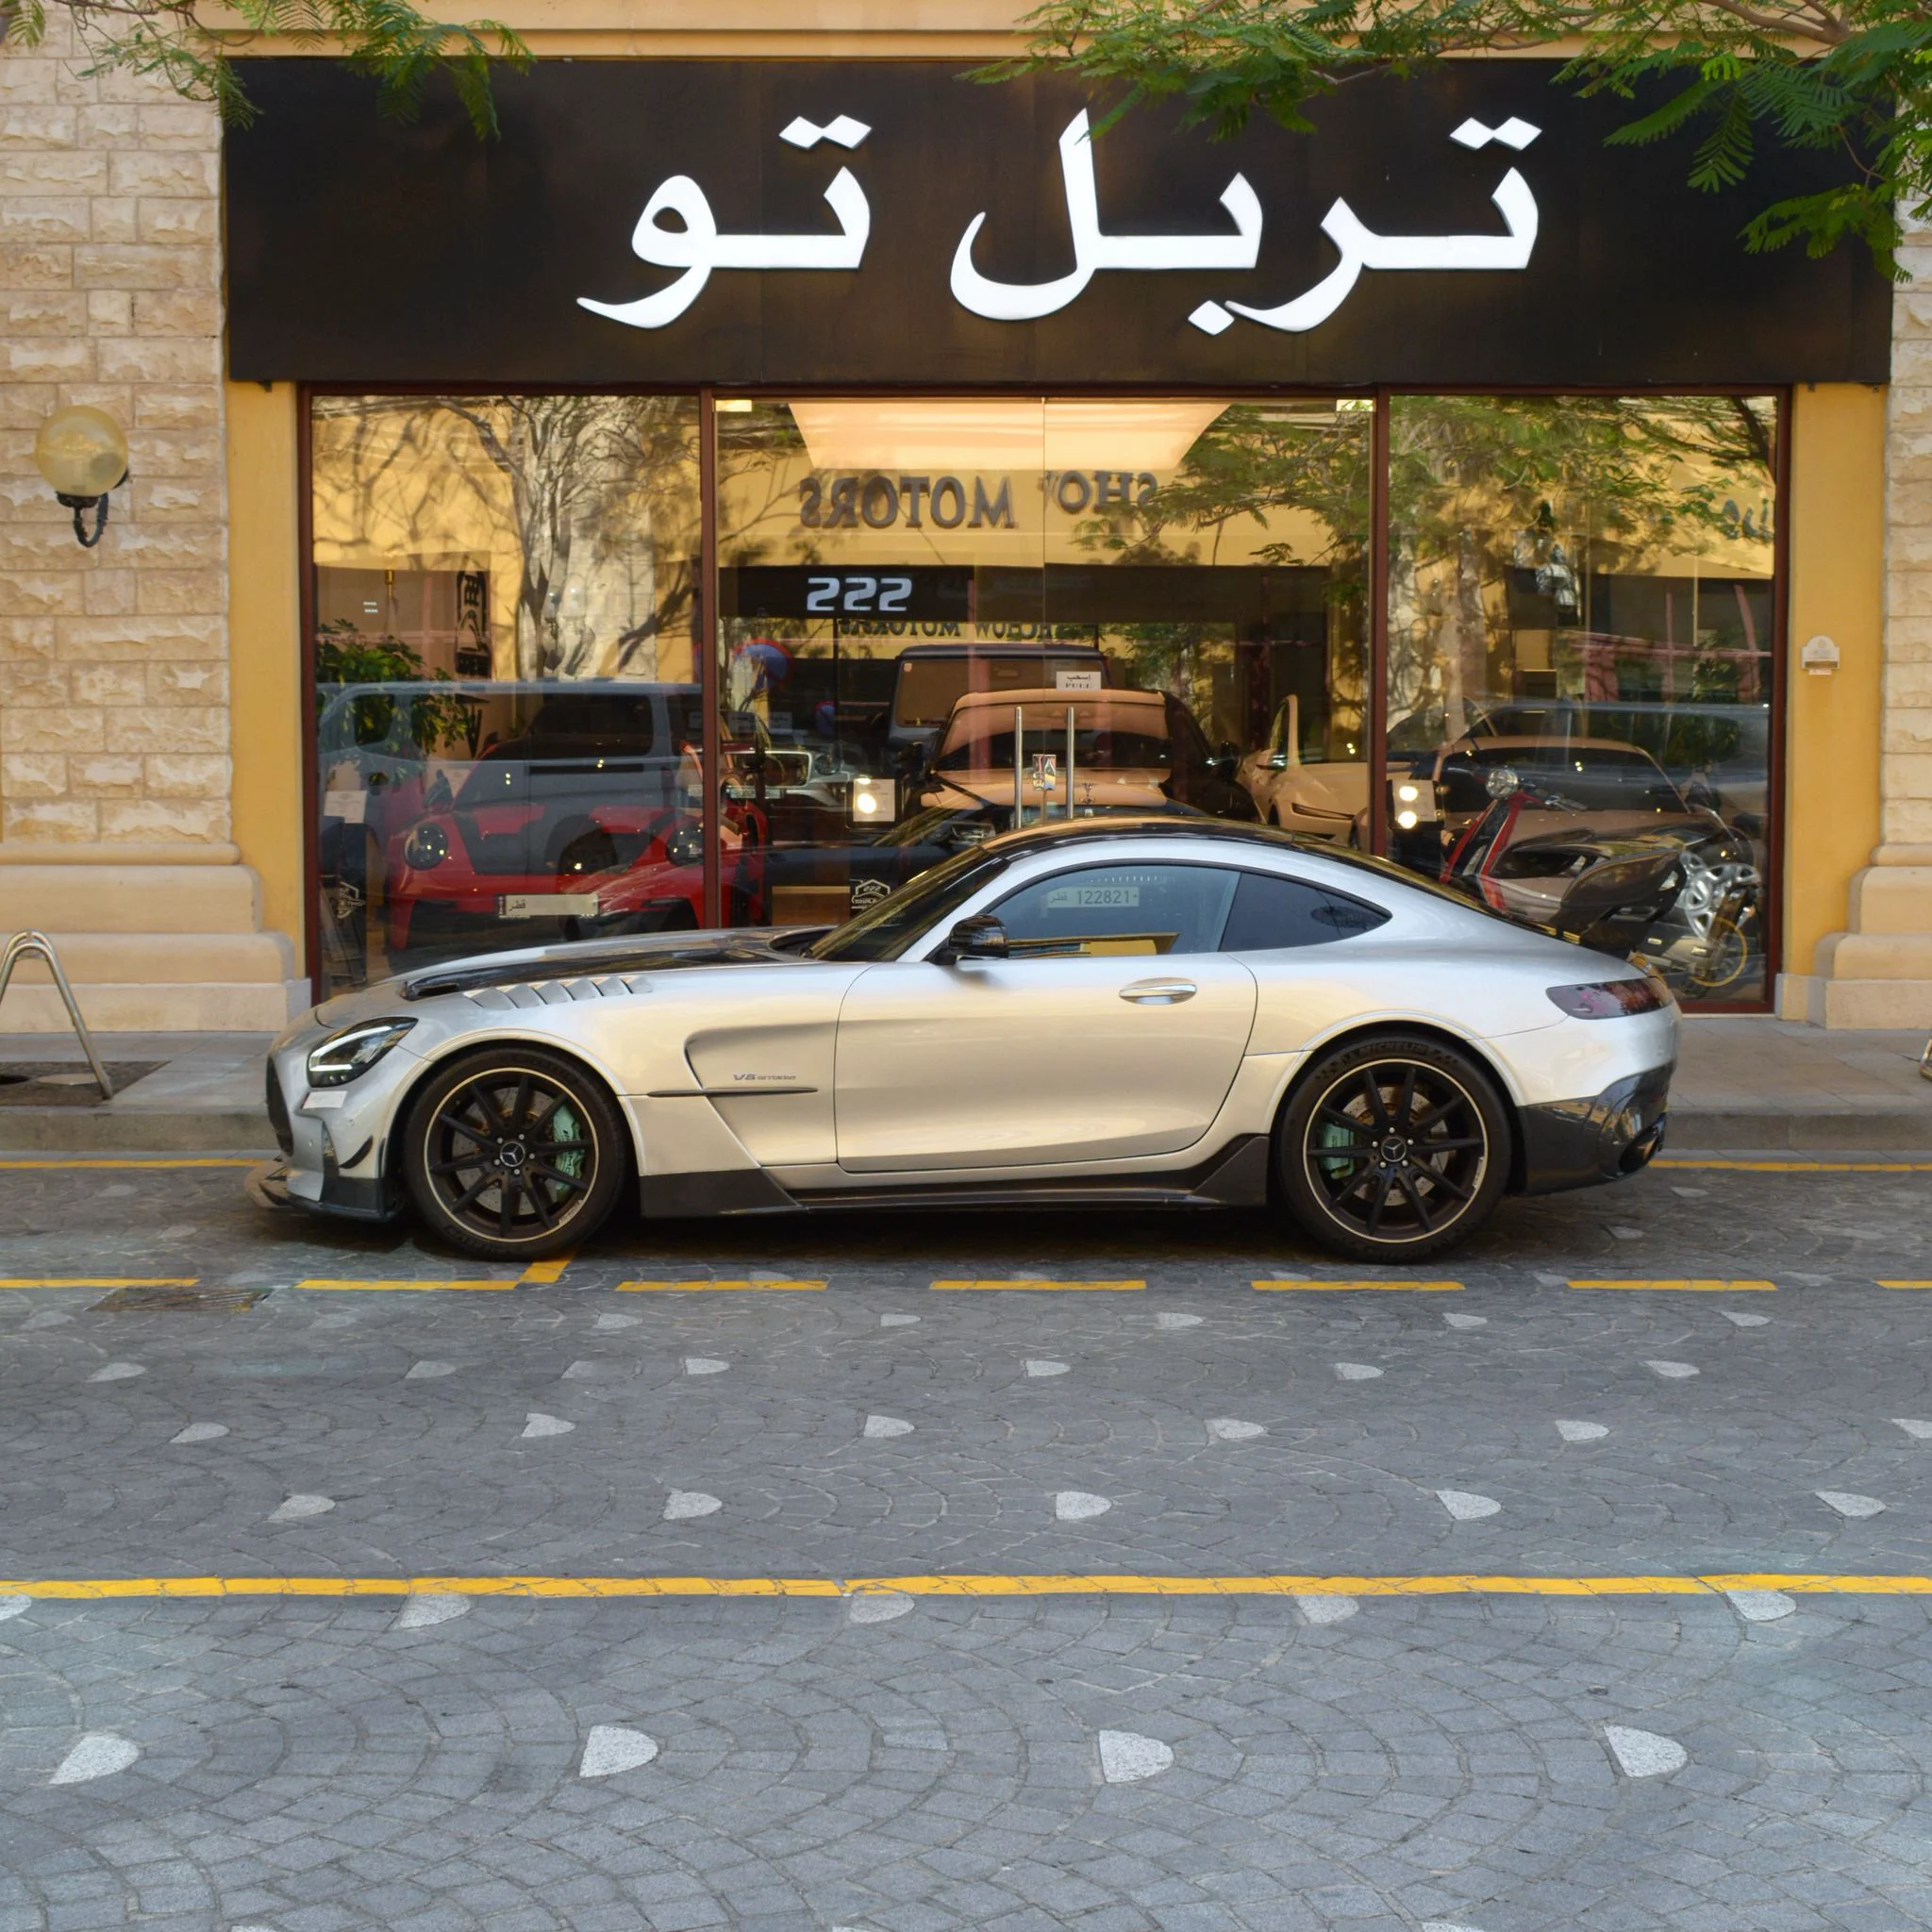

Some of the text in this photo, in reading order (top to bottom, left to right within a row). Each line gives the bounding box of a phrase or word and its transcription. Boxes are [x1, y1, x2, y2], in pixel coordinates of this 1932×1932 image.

[576, 108, 1541, 335] تربل تو
[807, 577, 912, 611] 222
[508, 898, 527, 912] قطر
[1076, 890, 1130, 905] 122821
[733, 1073, 757, 1081] V8
